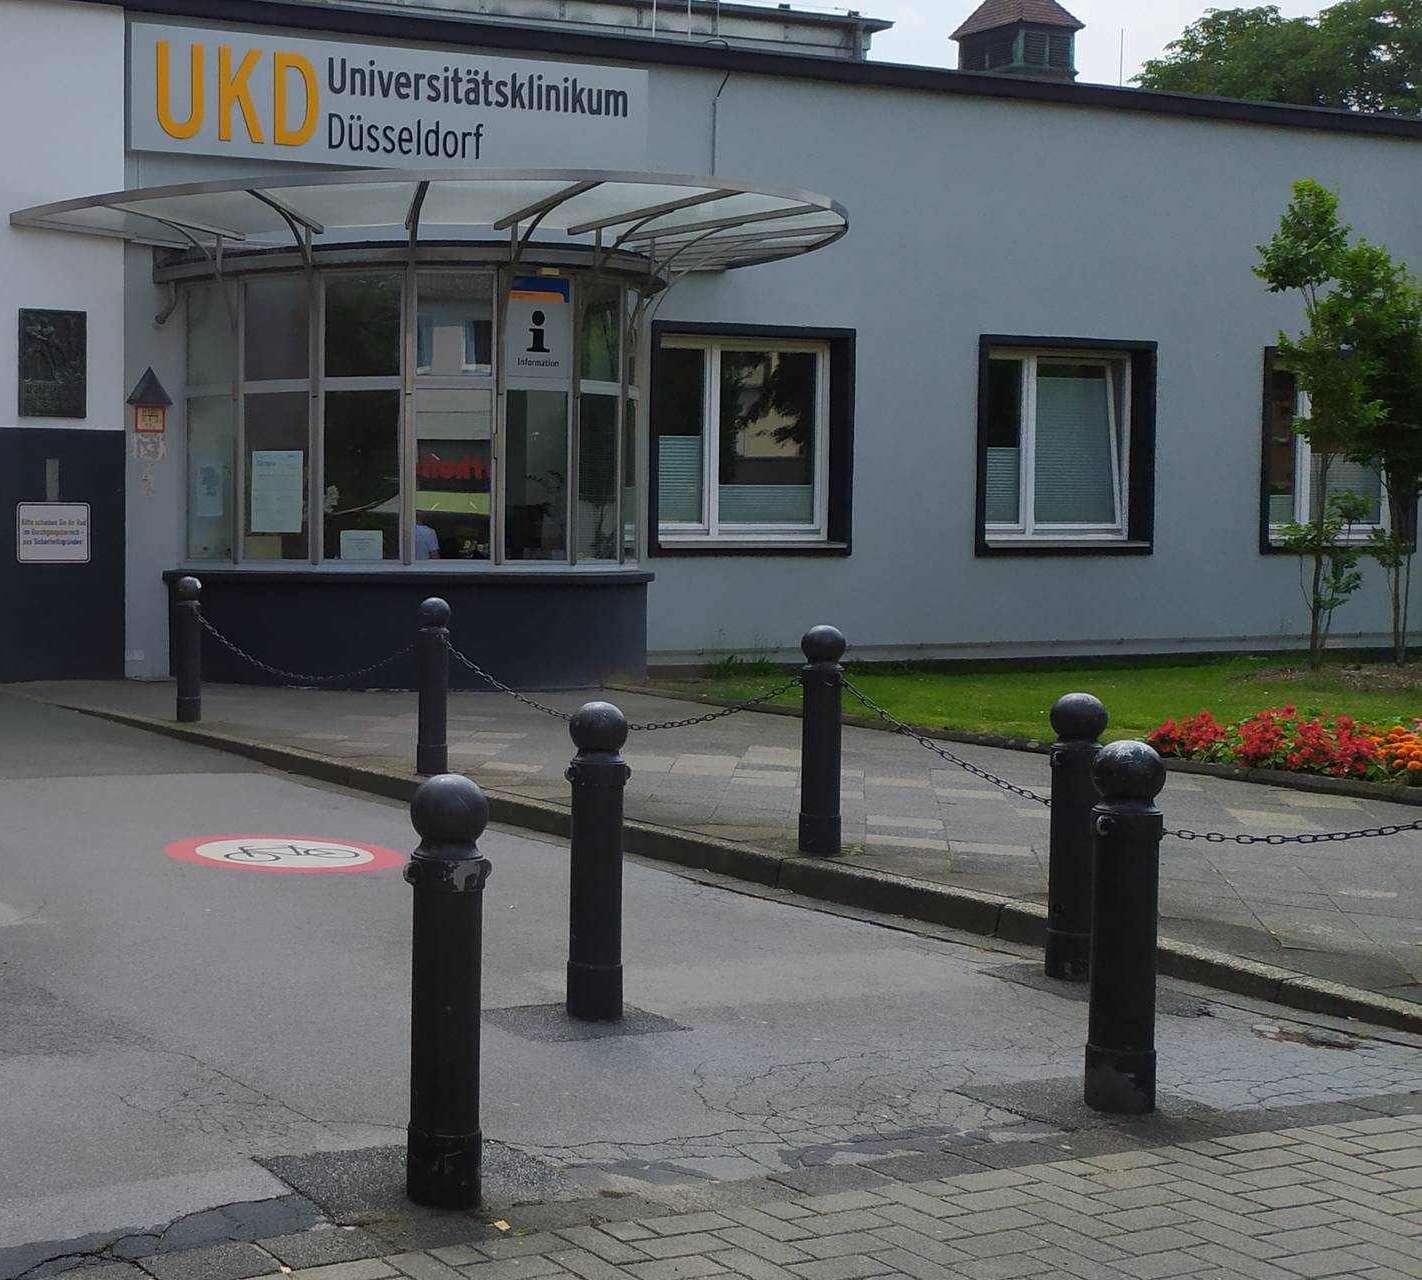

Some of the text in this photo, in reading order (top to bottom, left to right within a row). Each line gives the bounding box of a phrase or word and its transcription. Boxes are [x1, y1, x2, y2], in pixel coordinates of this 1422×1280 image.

[155, 40, 319, 146] UKD
[327, 57, 629, 118] Universitätsklinikum
[327, 113, 484, 160] Düsseldorf
[517, 358, 560, 368] Information
